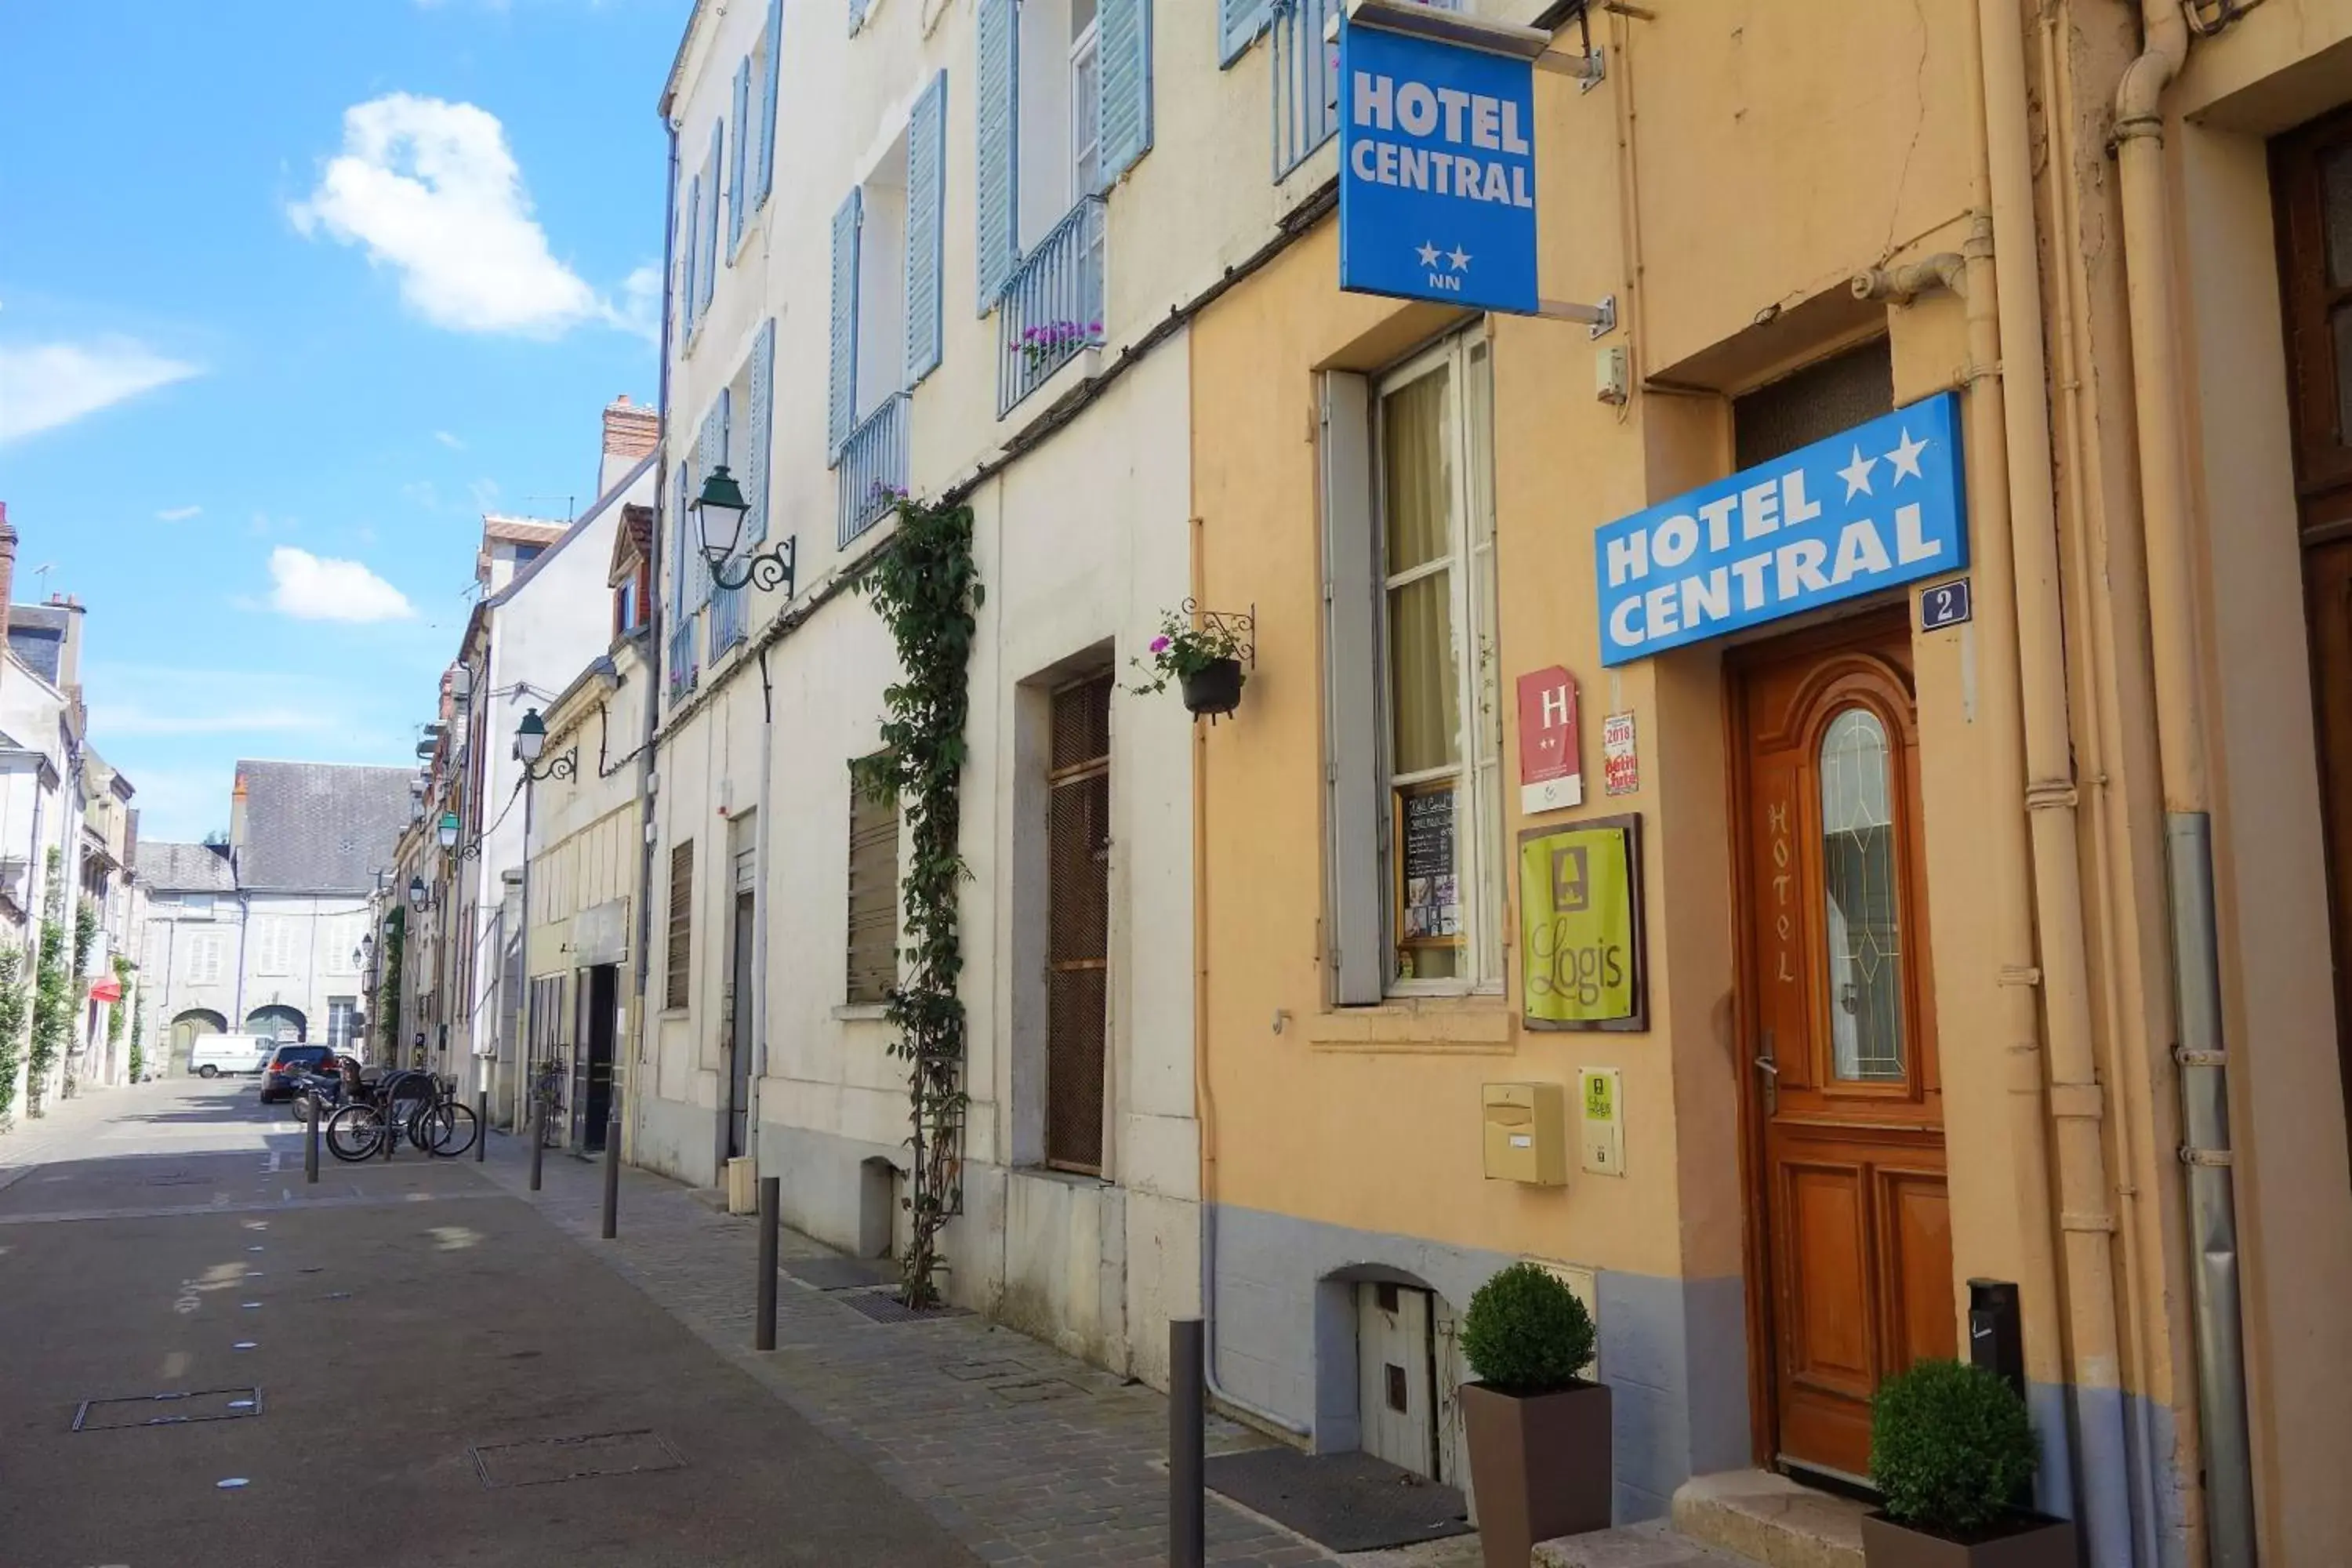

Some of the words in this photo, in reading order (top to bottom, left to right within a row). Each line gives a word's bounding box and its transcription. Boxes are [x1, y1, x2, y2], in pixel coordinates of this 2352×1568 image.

[1354, 71, 1529, 156] HOTEL
[1351, 139, 1533, 208] CENTRAL
[1429, 273, 1460, 291] NN
[1606, 468, 1821, 587] HOTEL
[1610, 503, 1941, 647] CENTRAL
[1937, 590, 1953, 621] 2
[1541, 684, 1570, 729] H
[1607, 726, 1630, 743] 2018
[1531, 916, 1622, 1005] Logis
